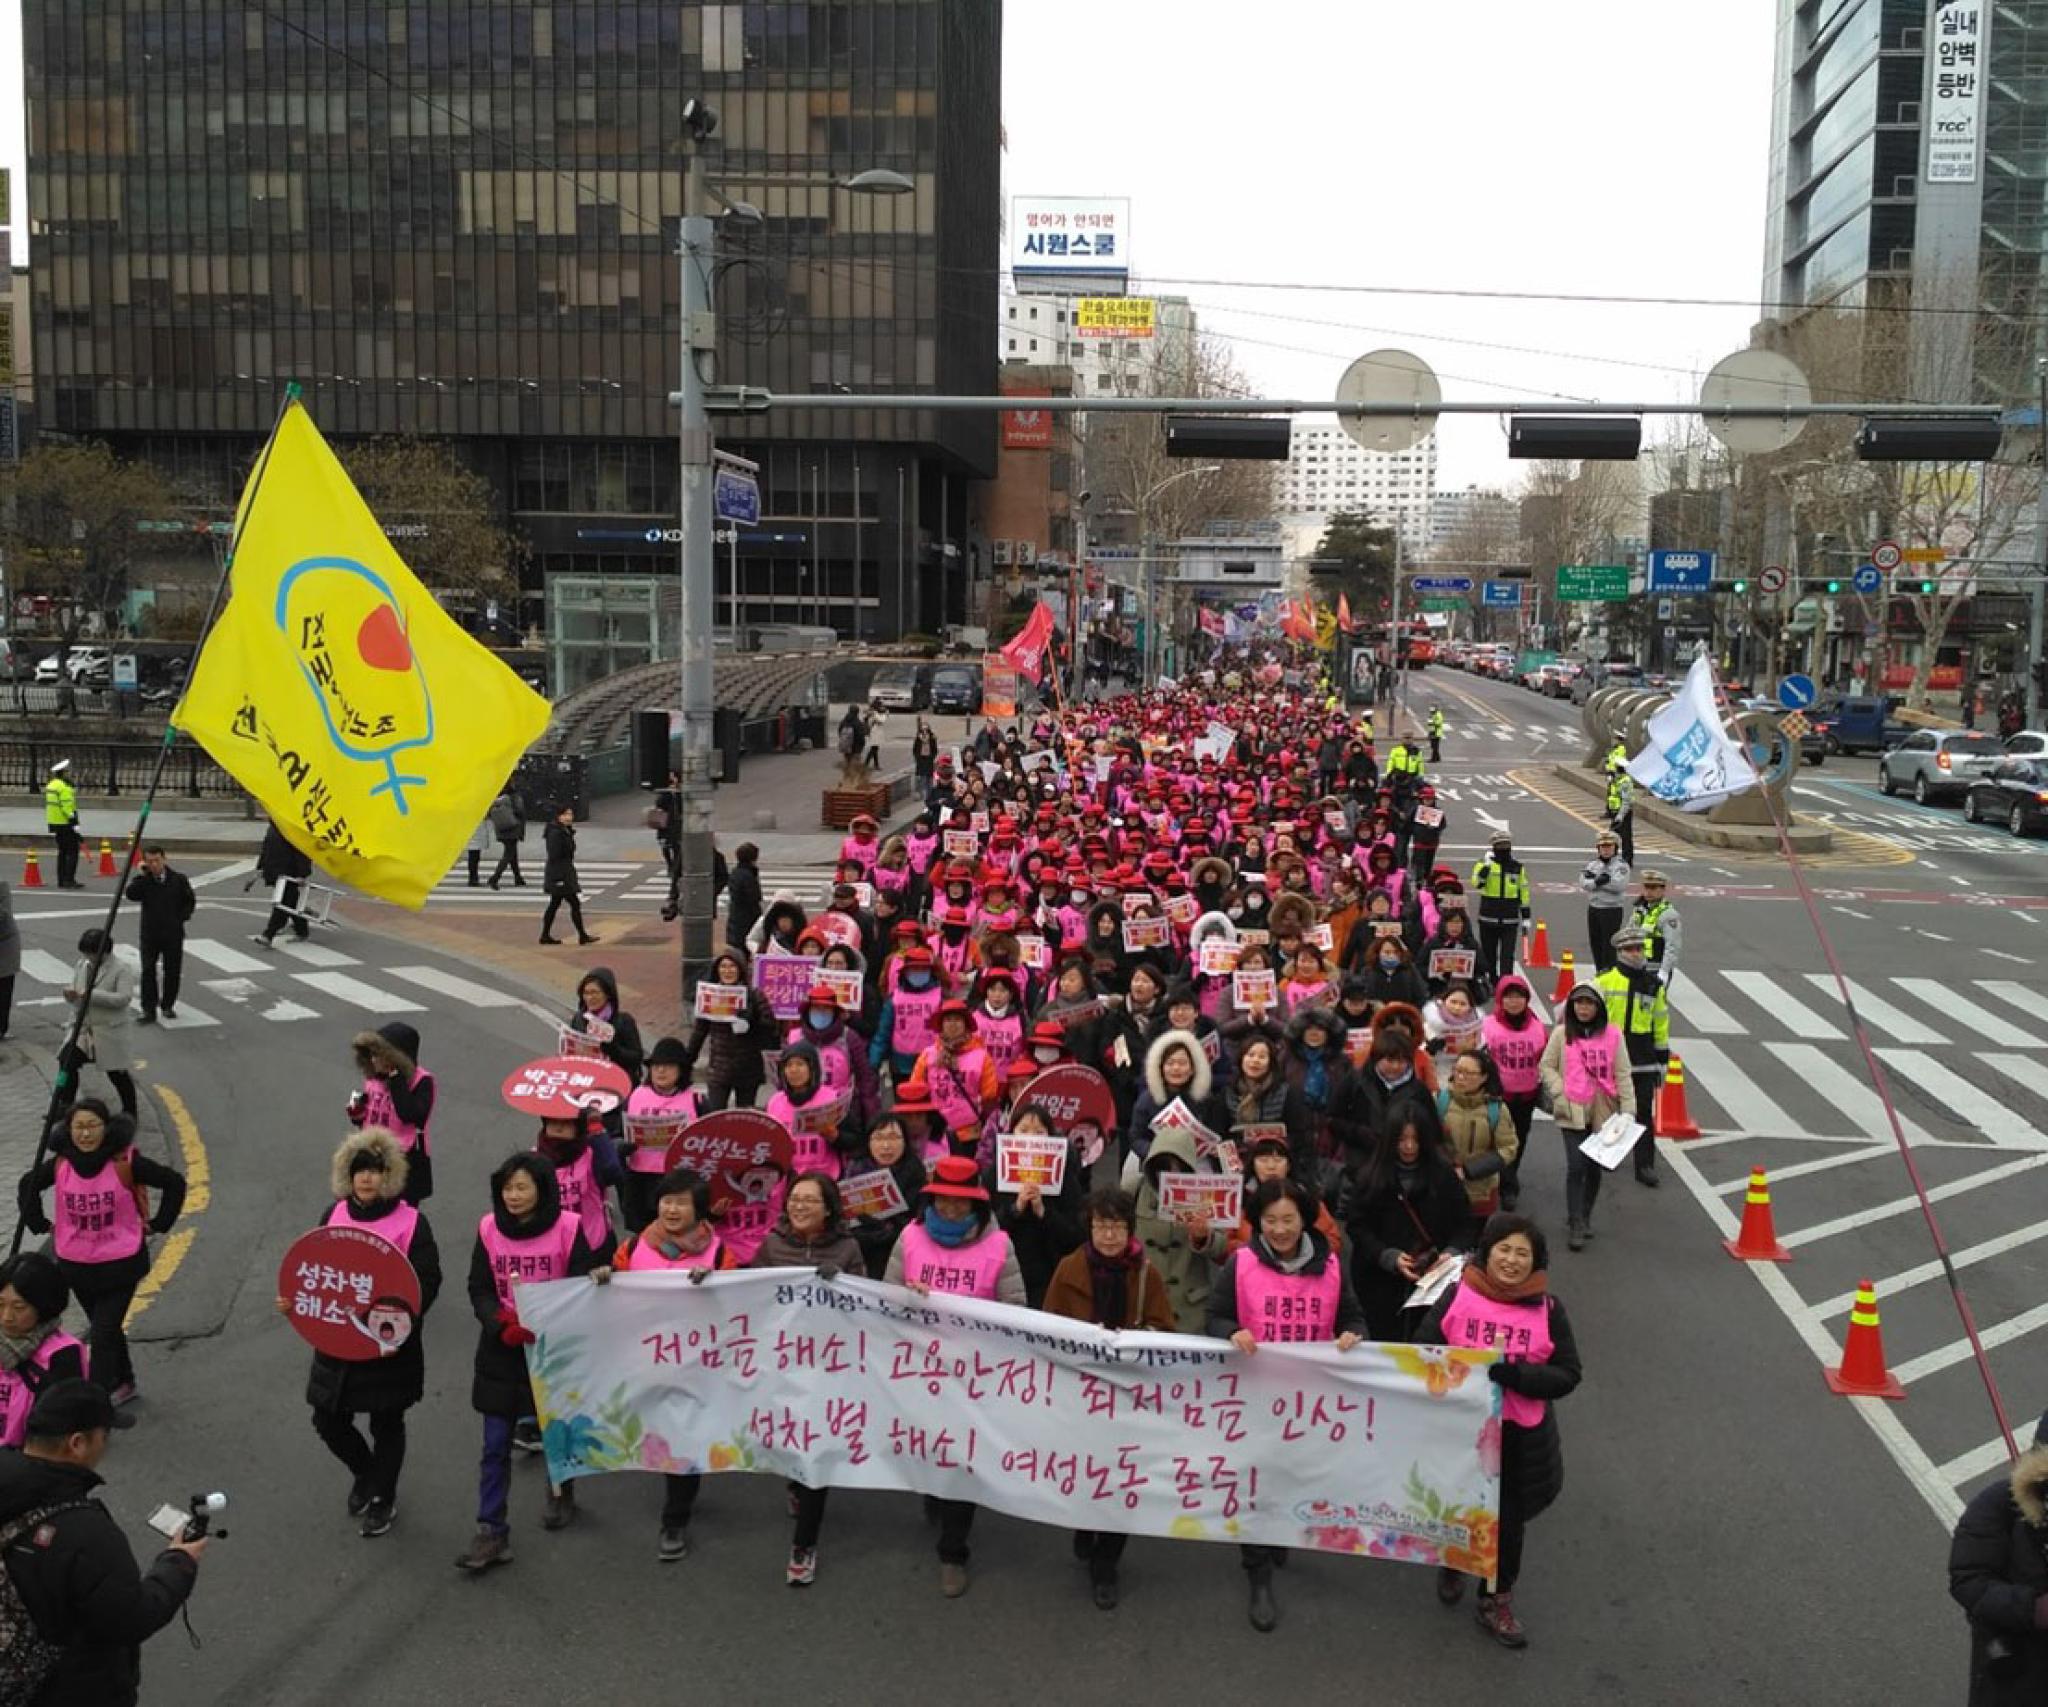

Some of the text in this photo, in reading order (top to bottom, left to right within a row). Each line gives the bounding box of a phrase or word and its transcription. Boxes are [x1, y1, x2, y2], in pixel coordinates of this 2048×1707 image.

[1940, 10, 1977, 36] 실내
[1938, 41, 1976, 67] 암벽
[1936, 73, 1975, 99] 등반
[1026, 212, 1066, 228] 영어가
[1023, 232, 1115, 256] 시원스쿨
[523, 1067, 595, 1087] 박근혜
[510, 1082, 558, 1101] 퇴진
[1030, 1093, 1082, 1121] 저임금
[682, 1135, 772, 1166] 여성노동
[495, 1254, 551, 1279] 비정규직
[920, 1263, 977, 1291] 비정규직
[295, 1261, 374, 1304] 성차별
[294, 1290, 348, 1325] 해소
[1264, 1295, 1321, 1319] 비정규직
[1466, 1317, 1532, 1353] 비정규직
[641, 1313, 1376, 1443] 저임금 해소! 고용안정! 최저임금 인상!
[748, 1396, 1259, 1520] 성차별 해소! 여성노동 존중!
